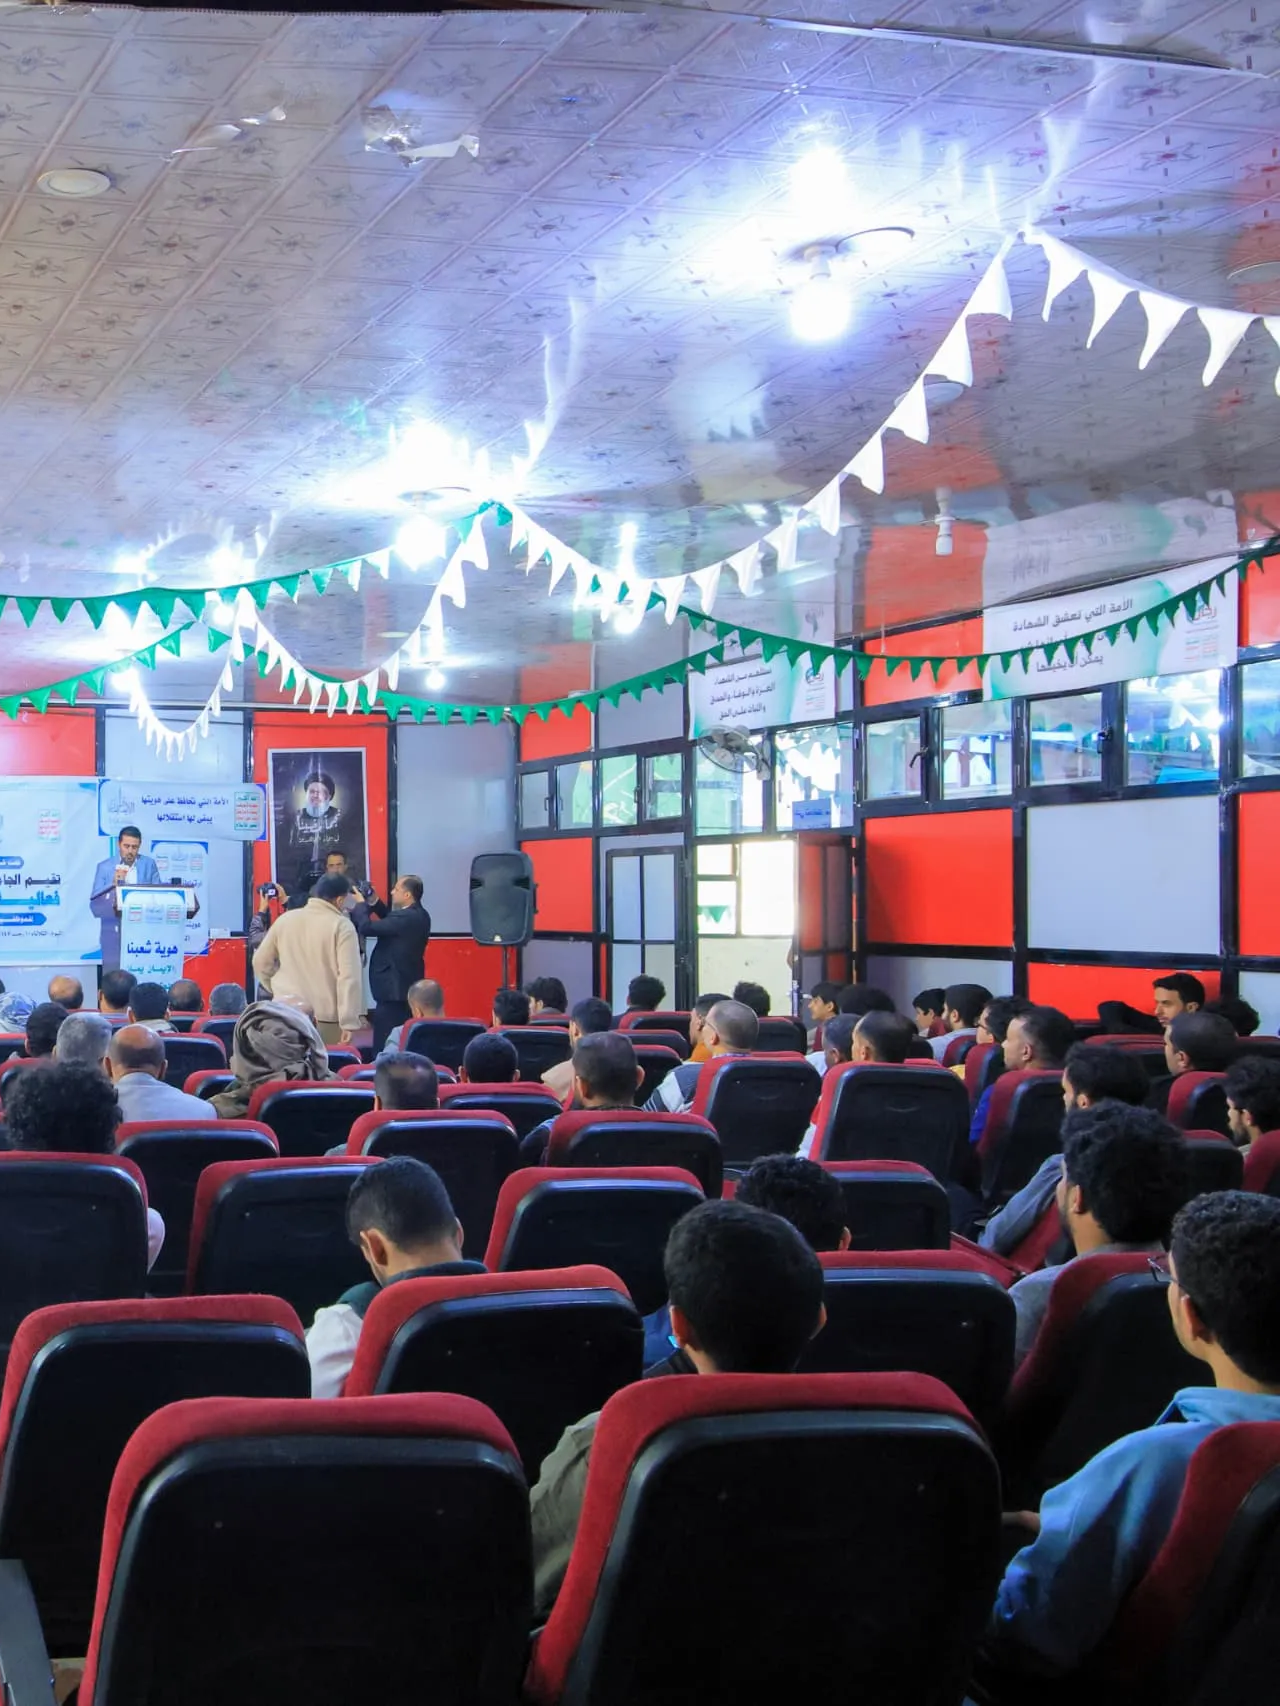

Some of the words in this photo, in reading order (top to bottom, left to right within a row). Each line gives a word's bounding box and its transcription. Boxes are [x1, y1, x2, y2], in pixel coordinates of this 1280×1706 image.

[1084, 604, 1106, 622] التي
[1109, 597, 1133, 614] الأمة
[1012, 615, 1049, 632] الشهادة
[1052, 611, 1082, 628] تعشق
[24, 873, 61, 889] تقيم
[127, 939, 152, 957] شعبنا
[154, 941, 179, 958] هوية
